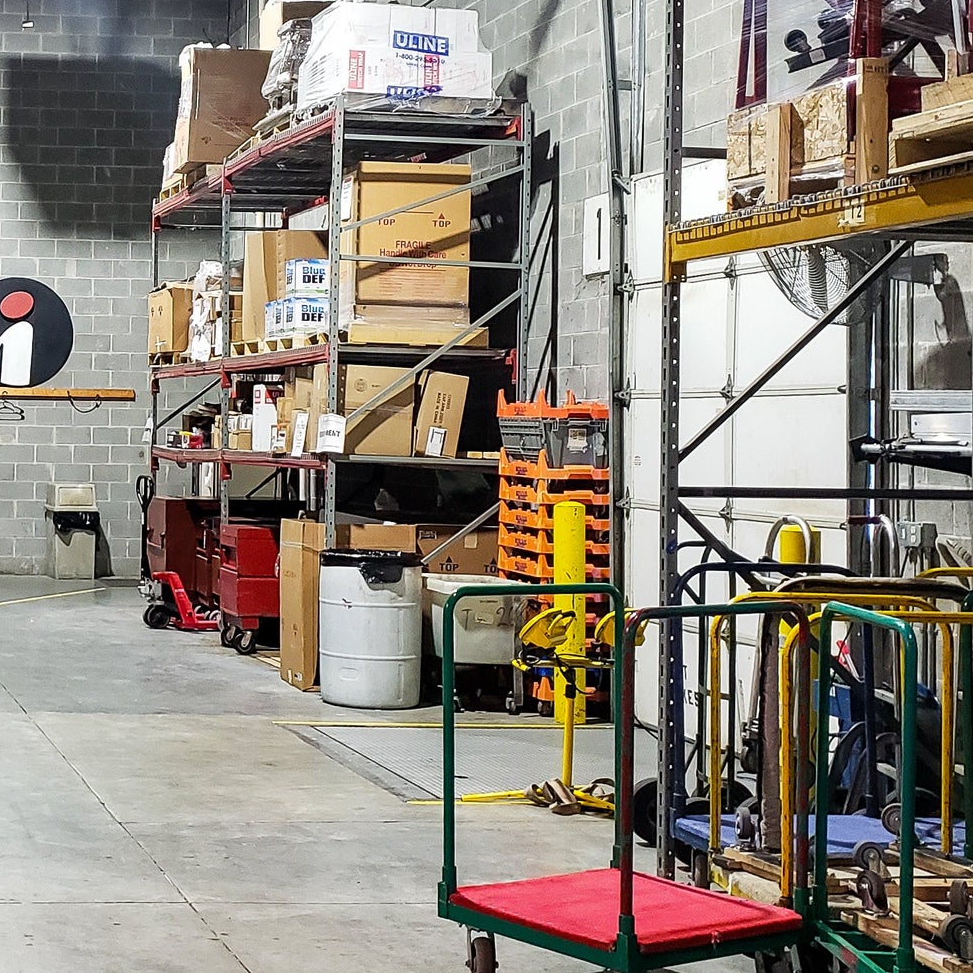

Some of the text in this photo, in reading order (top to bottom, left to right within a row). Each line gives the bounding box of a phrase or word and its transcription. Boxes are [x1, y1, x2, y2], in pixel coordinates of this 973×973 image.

[396, 33, 446, 54] ULINE
[432, 220, 451, 228] TOP
[596, 207, 602, 261] 1
[395, 240, 432, 249] FRAGILE
[427, 250, 447, 259] Care
[302, 275, 325, 284] DEF
[301, 313, 324, 322] DEF
[439, 563, 459, 572] TOP
[484, 565, 499, 574] TO
